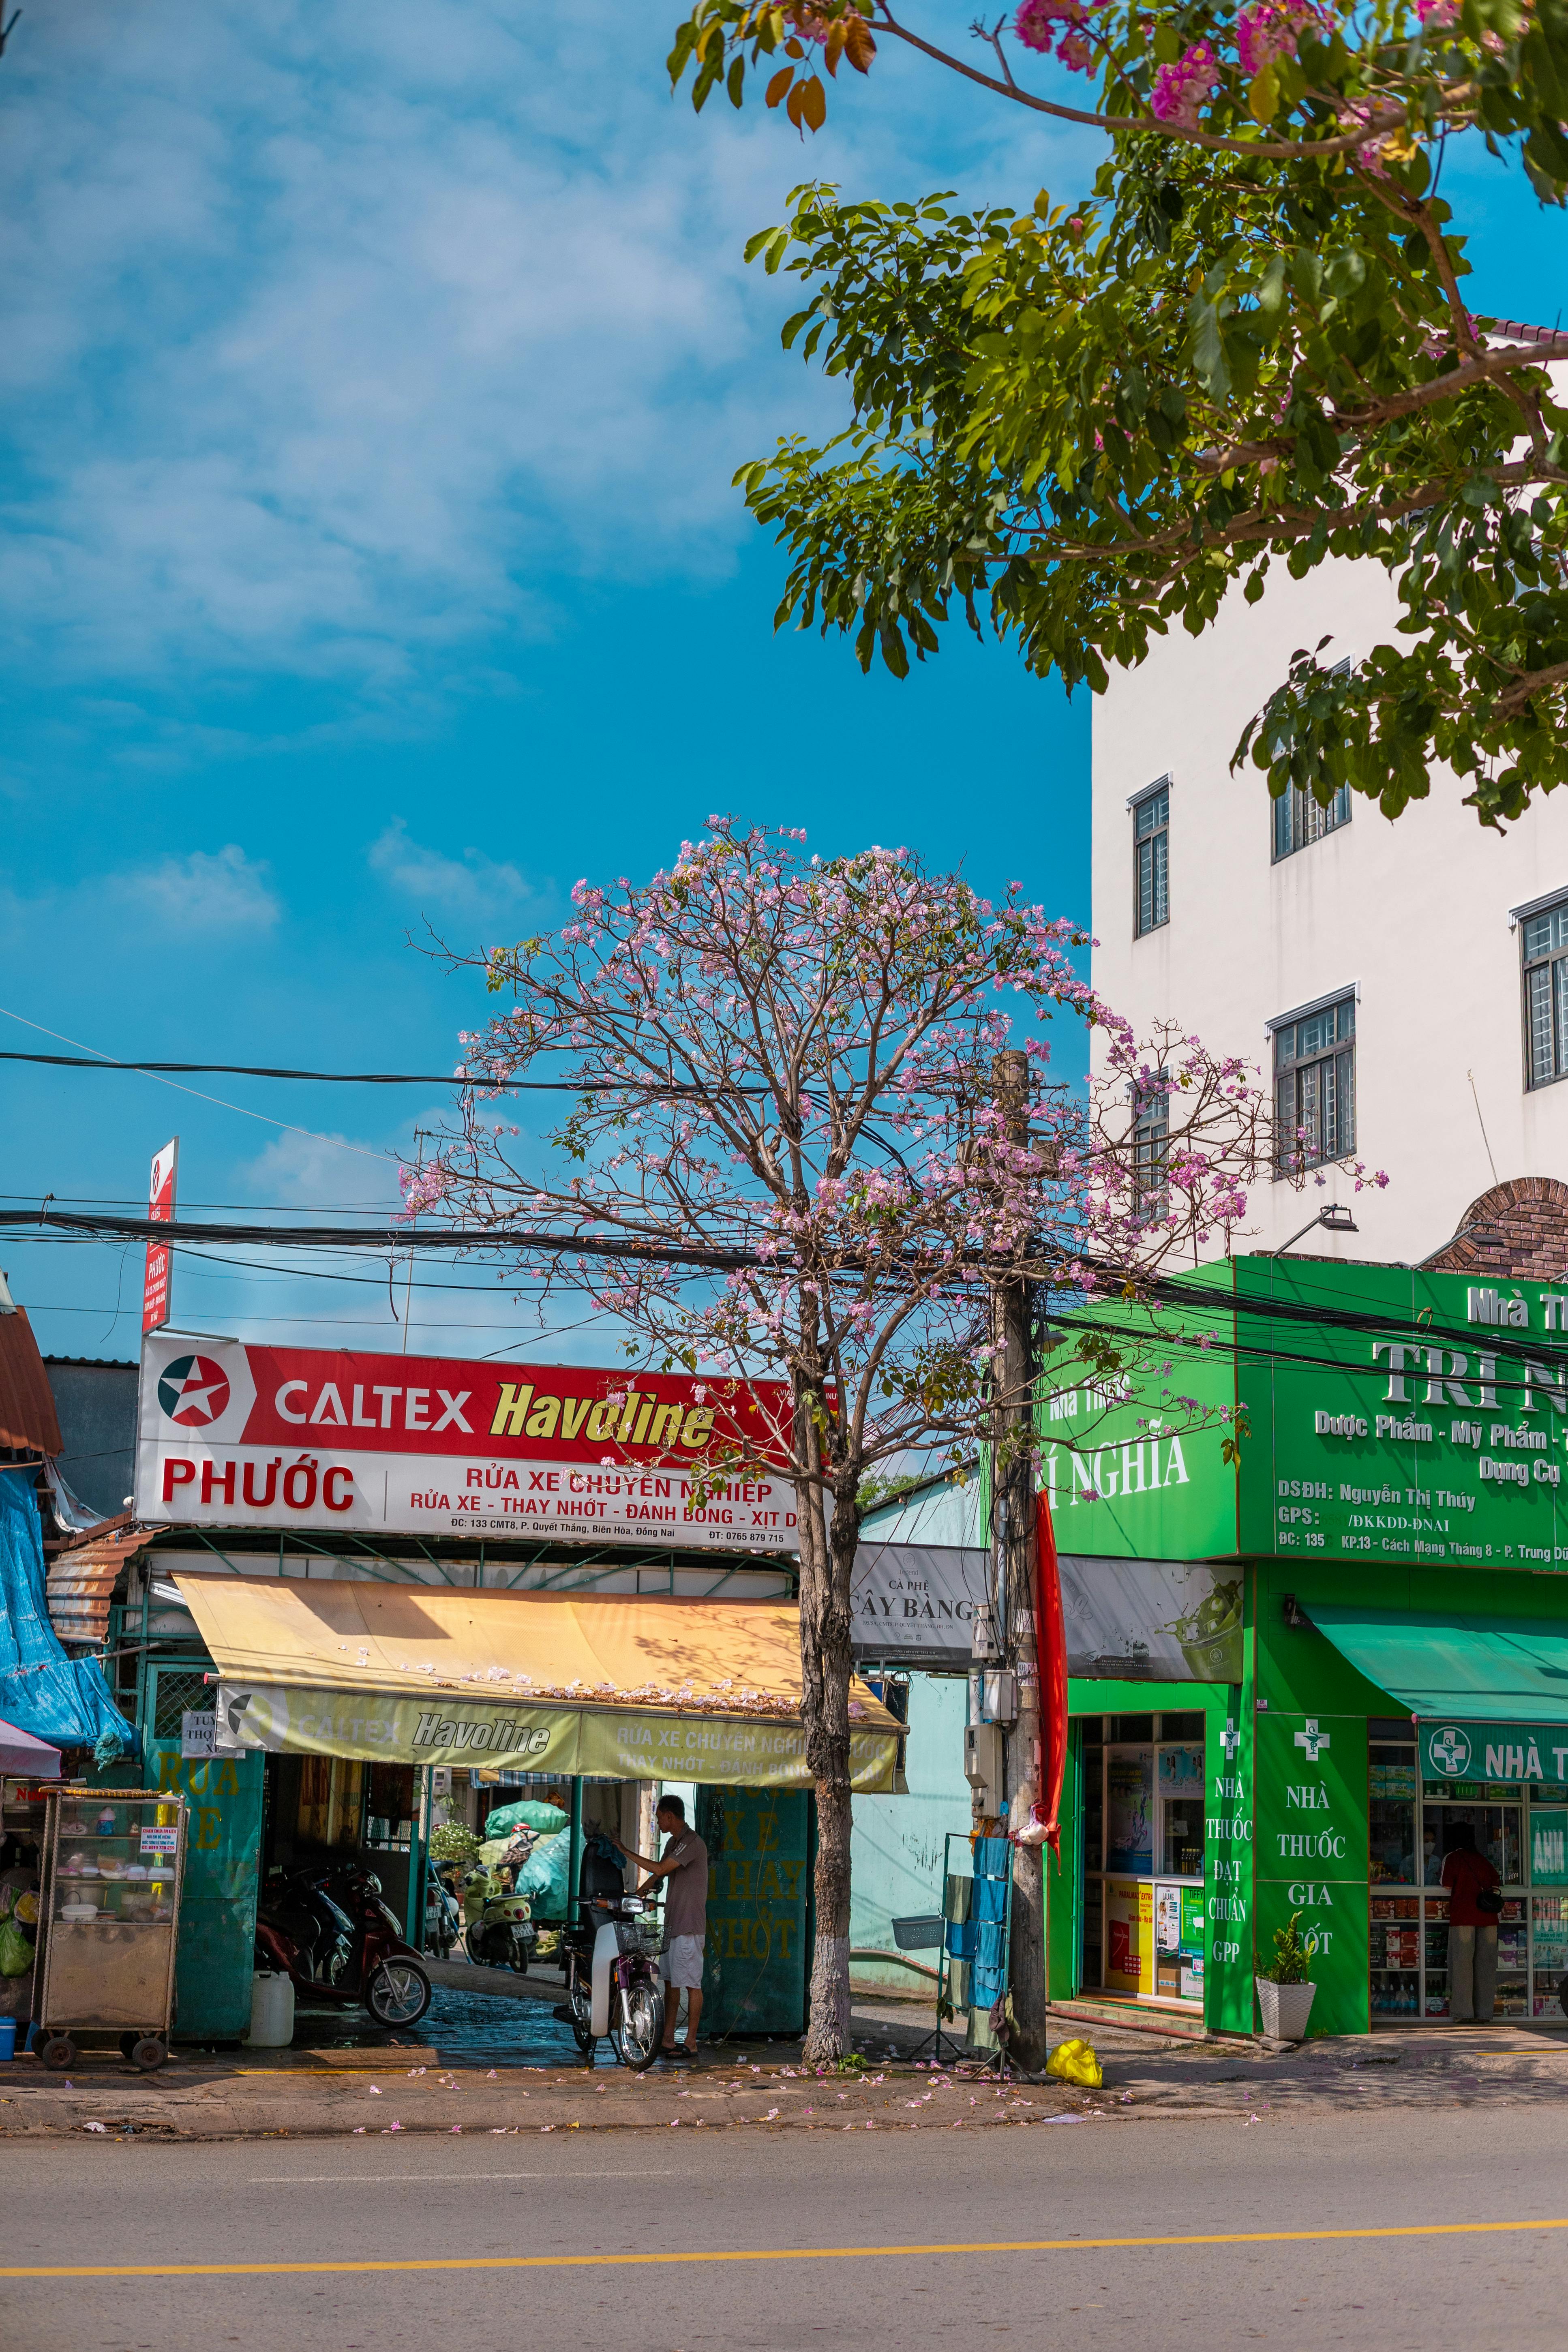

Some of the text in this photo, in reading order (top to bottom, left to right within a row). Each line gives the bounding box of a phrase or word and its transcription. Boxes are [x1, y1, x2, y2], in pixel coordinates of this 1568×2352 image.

[148, 1252, 165, 1281] PHƯỚC
[1467, 1287, 1529, 1327] Nhà
[275, 1380, 715, 1448] CALTEX Havoline
[1315, 1411, 1368, 1441] Dược
[1376, 1412, 1432, 1442] Phẩm
[1451, 1420, 1482, 1449] Mỹ
[1491, 1421, 1547, 1450] Phẩm
[1070, 1416, 1190, 1506] NGHĨA
[1480, 1456, 1560, 1488] Dụng Cụ
[162, 1454, 354, 1512] PHƯỚC
[467, 1463, 520, 1490] RỬA
[528, 1471, 559, 1492] XE
[681, 1479, 772, 1507] NGHIỆP
[1278, 1480, 1476, 1512] DSĐH: Nguyễn Thị Thúy
[411, 1488, 450, 1509] RỬA
[457, 1495, 481, 1511] XE
[501, 1497, 550, 1514] THAY
[557, 1498, 607, 1517] NHỚT
[625, 1501, 676, 1521] ĐÁNH
[751, 1510, 780, 1529] XỊT
[1278, 1506, 1320, 1525] GPS:
[451, 1518, 467, 1527] ĐC:
[471, 1519, 487, 1528] 133
[490, 1520, 518, 1530] CMT8,
[532, 1522, 557, 1533] Quyết
[560, 1523, 589, 1534] Thắng,
[593, 1525, 610, 1534] Biên
[614, 1526, 633, 1536] Hòa,
[636, 1527, 657, 1537] Đồng
[661, 1528, 675, 1537] Nai
[709, 1531, 784, 1542] ĐT: 0765 879 715
[1279, 1532, 1300, 1546] ĐC:
[1305, 1533, 1325, 1547] 135
[1342, 1536, 1371, 1549] KP.13
[1382, 1538, 1410, 1552] Cách
[1414, 1540, 1445, 1557] Mạng
[1449, 1542, 1482, 1559] Tháng
[1486, 1544, 1493, 1557] 8
[1505, 1545, 1514, 1558] P.
[1518, 1544, 1551, 1563] Trung
[889, 1579, 929, 1591] CÀ PHÊ
[902, 1593, 973, 1621] BÀNG
[186, 1729, 213, 1742] THỢ
[298, 1712, 551, 1754] CALTEX Havoline
[617, 1723, 652, 1746] RỬA
[659, 1730, 679, 1748] XE
[686, 1731, 755, 1752] CHUYÊN
[617, 1753, 657, 1768] THAY
[662, 1755, 706, 1771] NHỚT
[720, 1758, 763, 1775] ĐÁNH
[769, 1762, 812, 1778] BÓNG
[1486, 1737, 1543, 1779] NHÀ
[1215, 1771, 1245, 1798] NHÀ
[1286, 1780, 1330, 1809] NHÀ
[723, 1812, 779, 1851] XE
[1206, 1807, 1253, 1841] THUỐC
[1277, 1827, 1346, 1858] THUỐC
[1214, 1859, 1242, 1886] ĐẠT
[1189, 1889, 1204, 1900] TIFFY
[1209, 1887, 1246, 1922] CHUẨN
[1288, 1884, 1333, 1905] GIA
[1213, 1941, 1240, 1963] GPP
